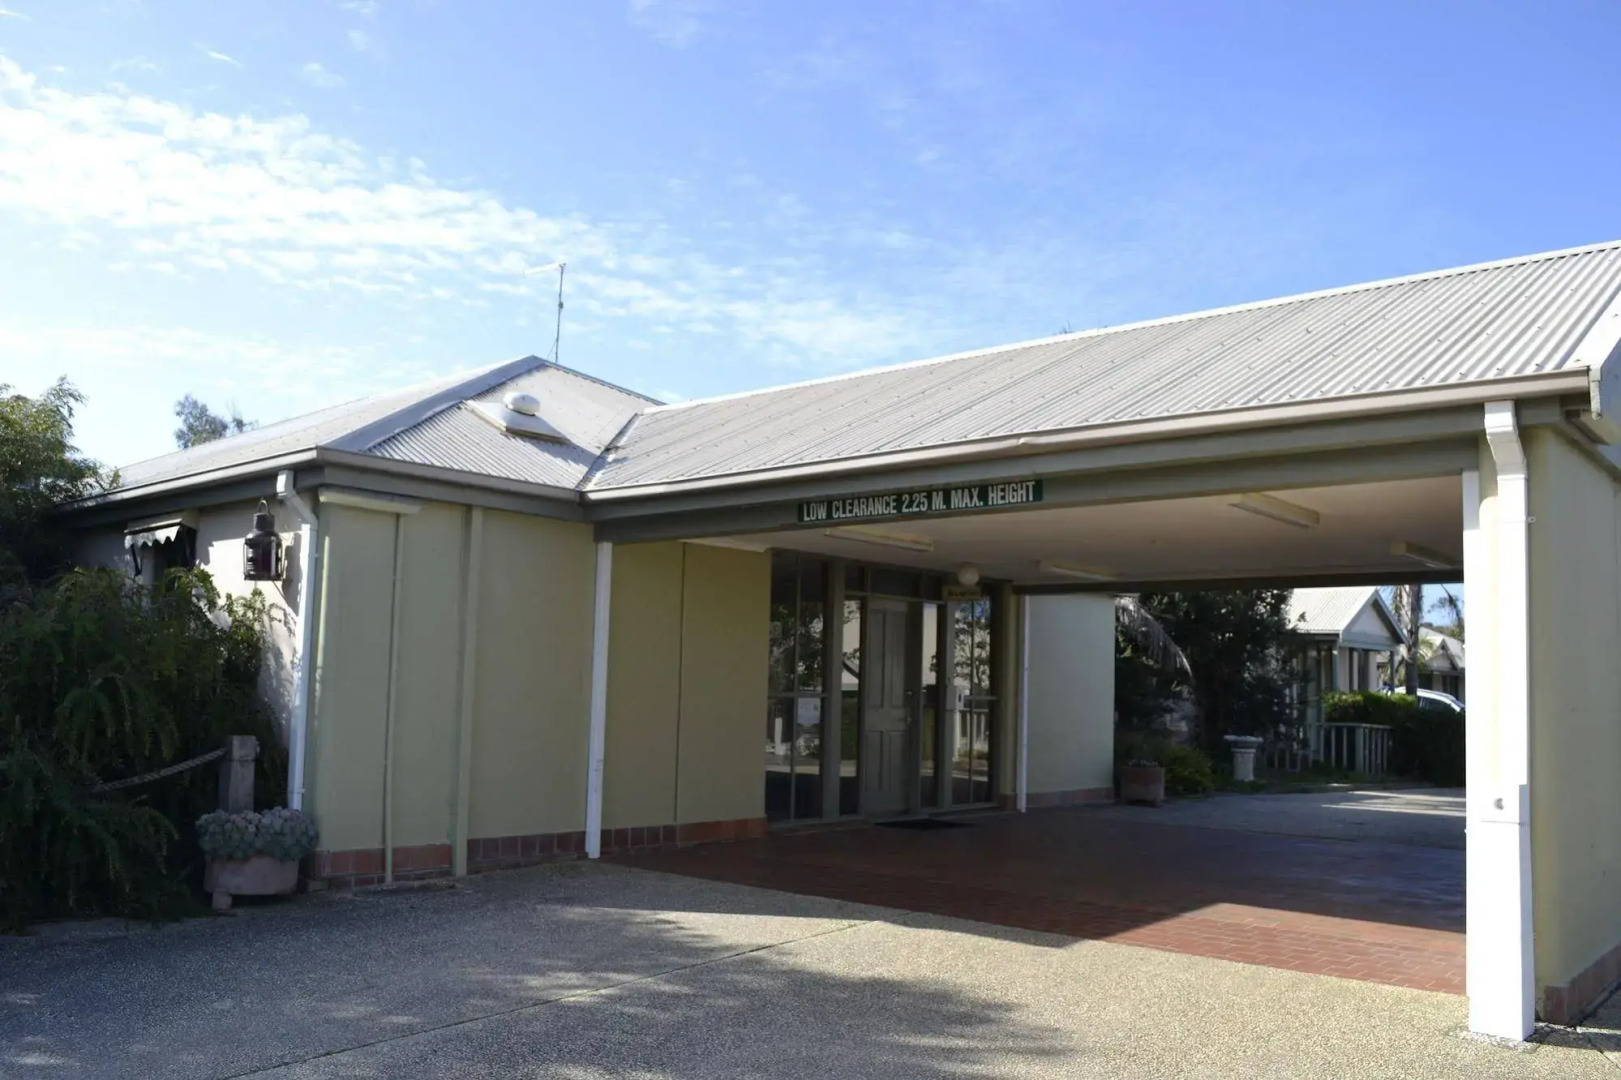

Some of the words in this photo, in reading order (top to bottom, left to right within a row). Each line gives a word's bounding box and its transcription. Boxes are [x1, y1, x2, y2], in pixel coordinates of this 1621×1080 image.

[803, 502, 827, 521] LOW
[832, 495, 897, 519] CLEARANCE
[901, 493, 928, 513] 2.25
[950, 487, 984, 508] MAX.
[988, 481, 1036, 505] HEIGHT
